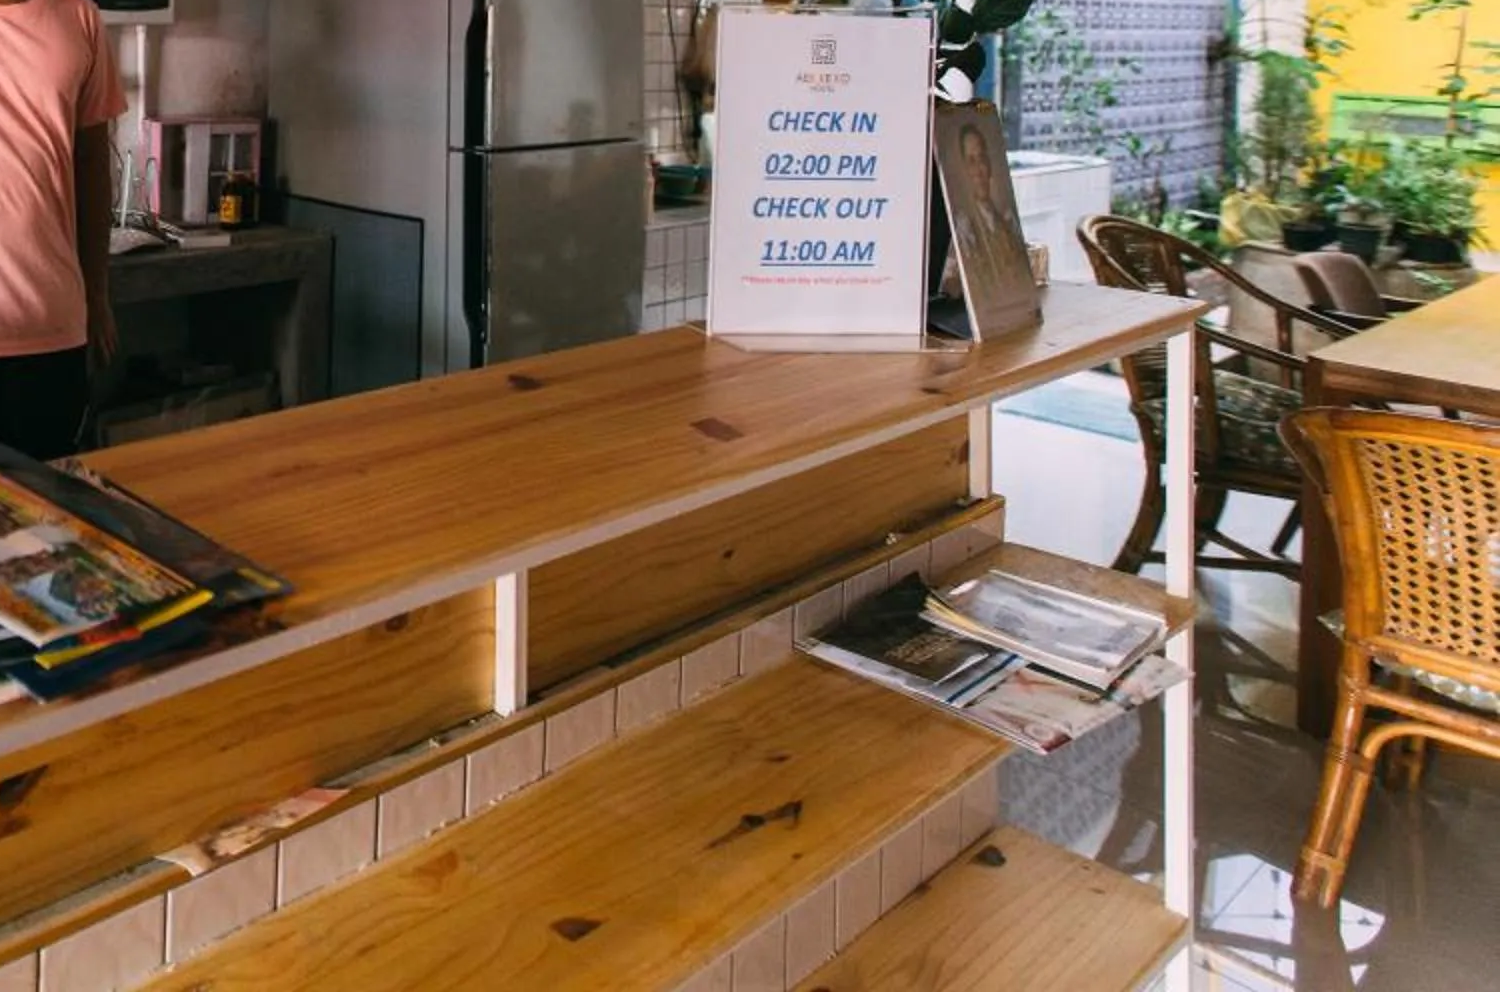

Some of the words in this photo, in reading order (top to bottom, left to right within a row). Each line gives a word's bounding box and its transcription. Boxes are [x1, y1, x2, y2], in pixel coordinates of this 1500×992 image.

[768, 110, 844, 133] CHECK
[850, 111, 877, 133] IN
[765, 153, 831, 176] 02:00
[836, 155, 877, 176] PM
[752, 196, 830, 219] CHECK
[835, 196, 889, 219] OUT
[761, 240, 827, 261] 11:00
[832, 241, 875, 261] AM
